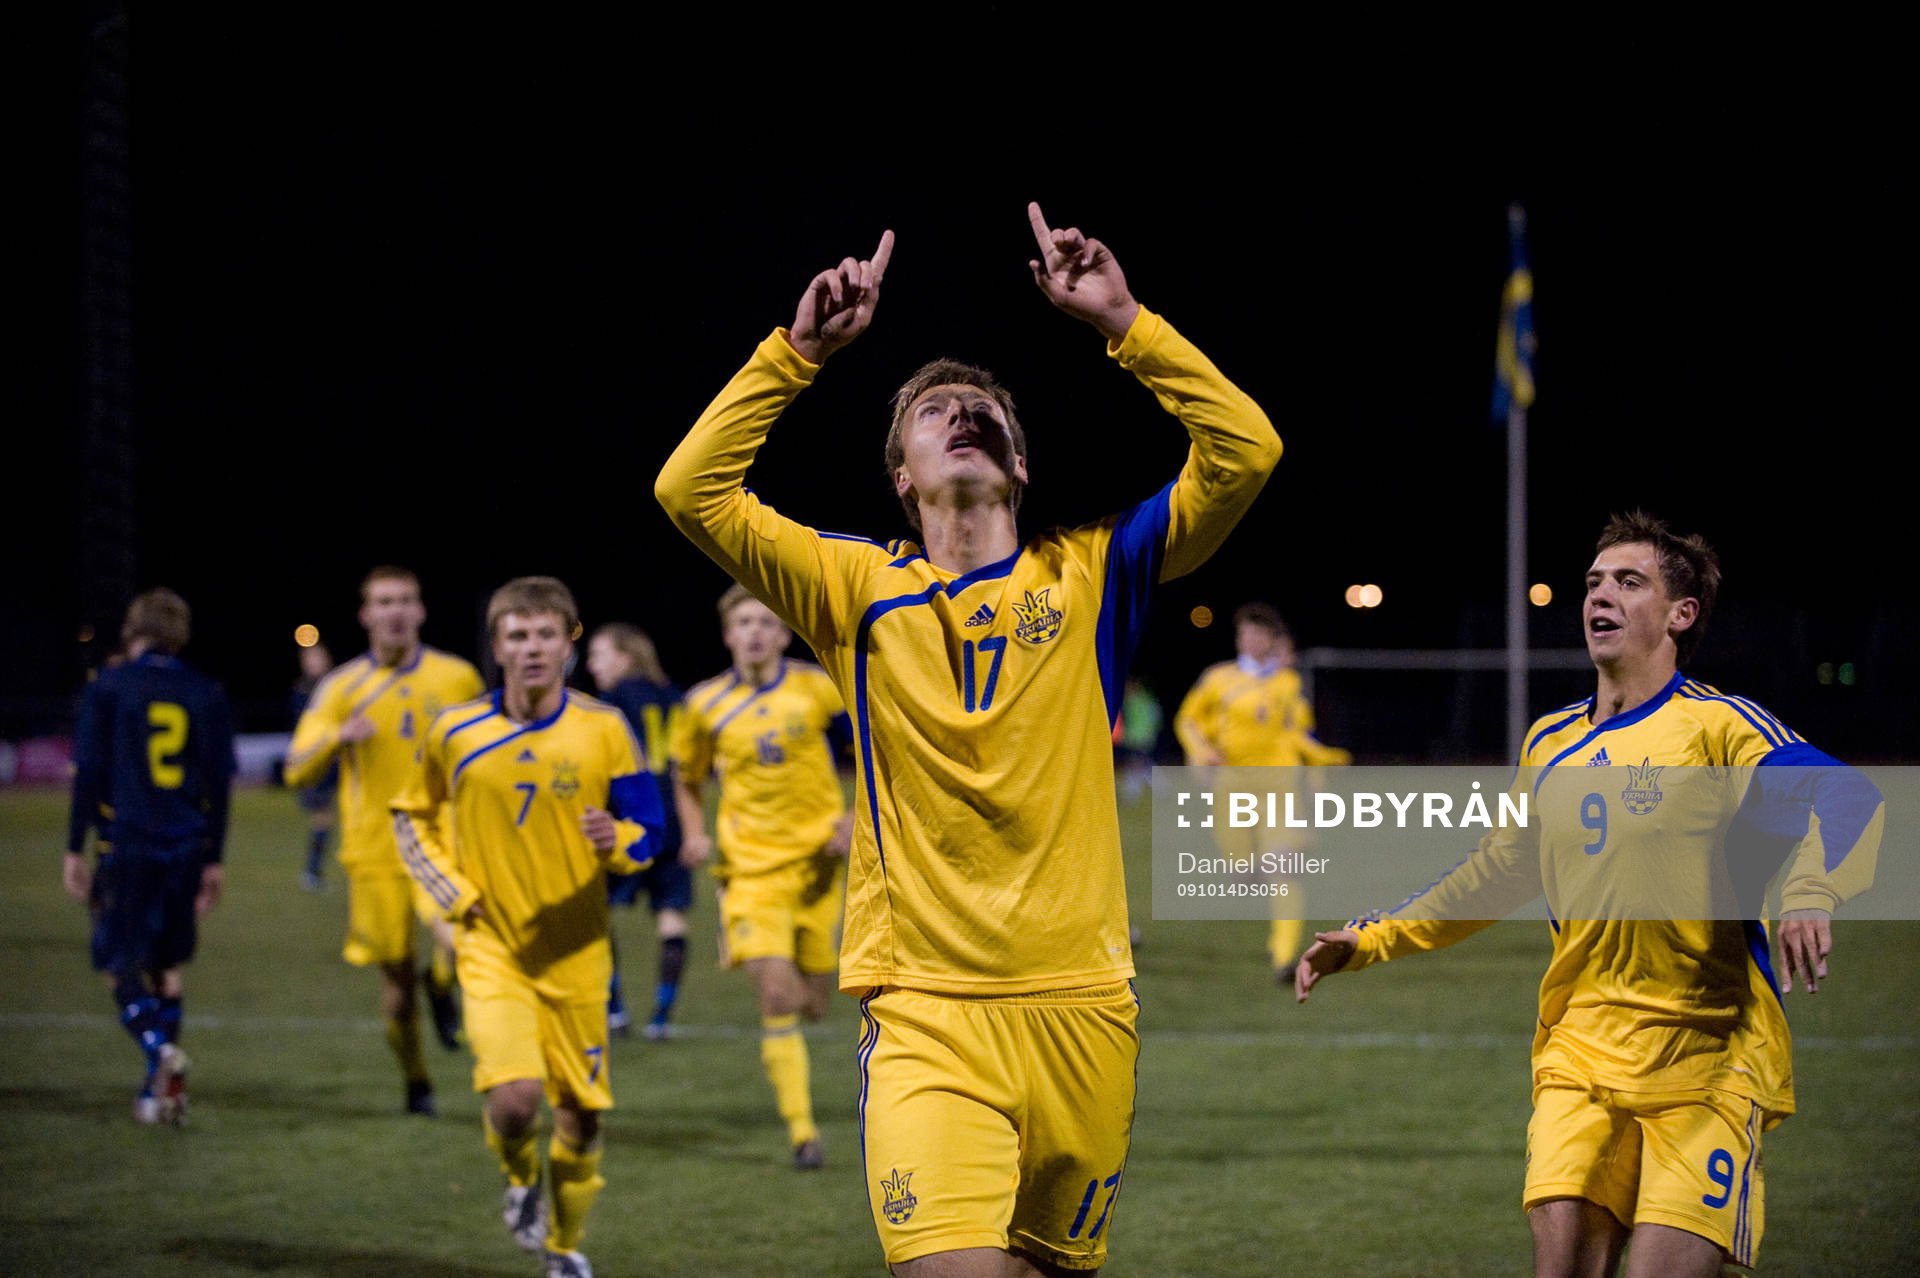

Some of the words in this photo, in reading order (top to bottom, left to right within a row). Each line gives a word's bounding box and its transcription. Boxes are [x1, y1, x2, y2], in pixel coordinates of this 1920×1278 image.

[963, 636, 1008, 713] 17
[147, 702, 189, 789] 2
[515, 782, 537, 827] 7
[1580, 792, 1607, 856] 9
[583, 1045, 602, 1083] 7
[1068, 1169, 1122, 1240] 17
[1702, 1148, 1734, 1210] 9
